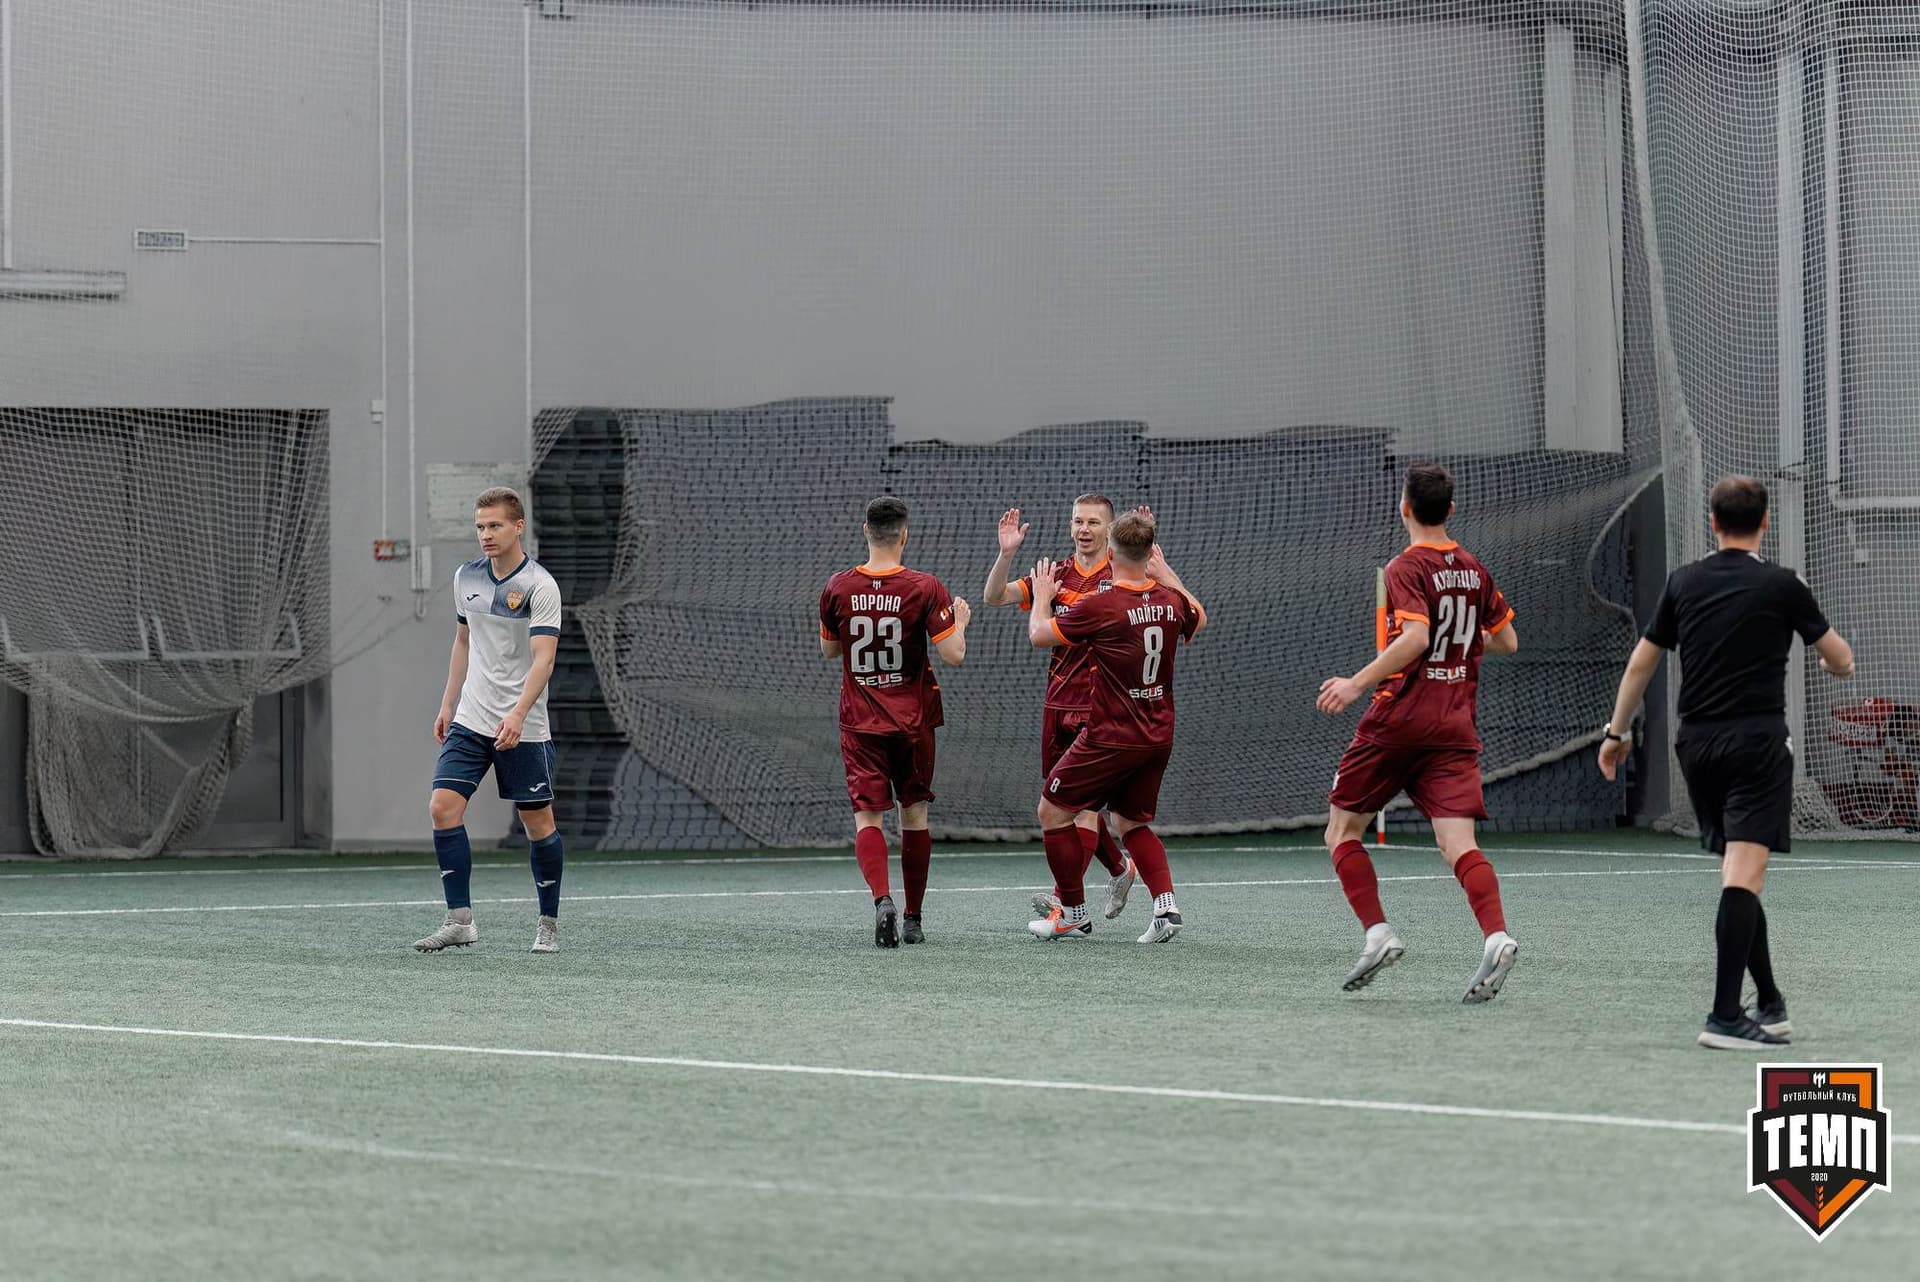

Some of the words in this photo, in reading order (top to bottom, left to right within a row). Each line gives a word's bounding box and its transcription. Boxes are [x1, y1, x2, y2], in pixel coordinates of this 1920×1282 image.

[851, 594, 902, 612] ВОРОНА
[1127, 604, 1164, 625] МАЙЕР
[1167, 604, 1177, 622] А.
[850, 615, 903, 673] 23
[1428, 595, 1477, 662] 24
[1142, 626, 1164, 685] 8
[1050, 777, 1061, 793] 8
